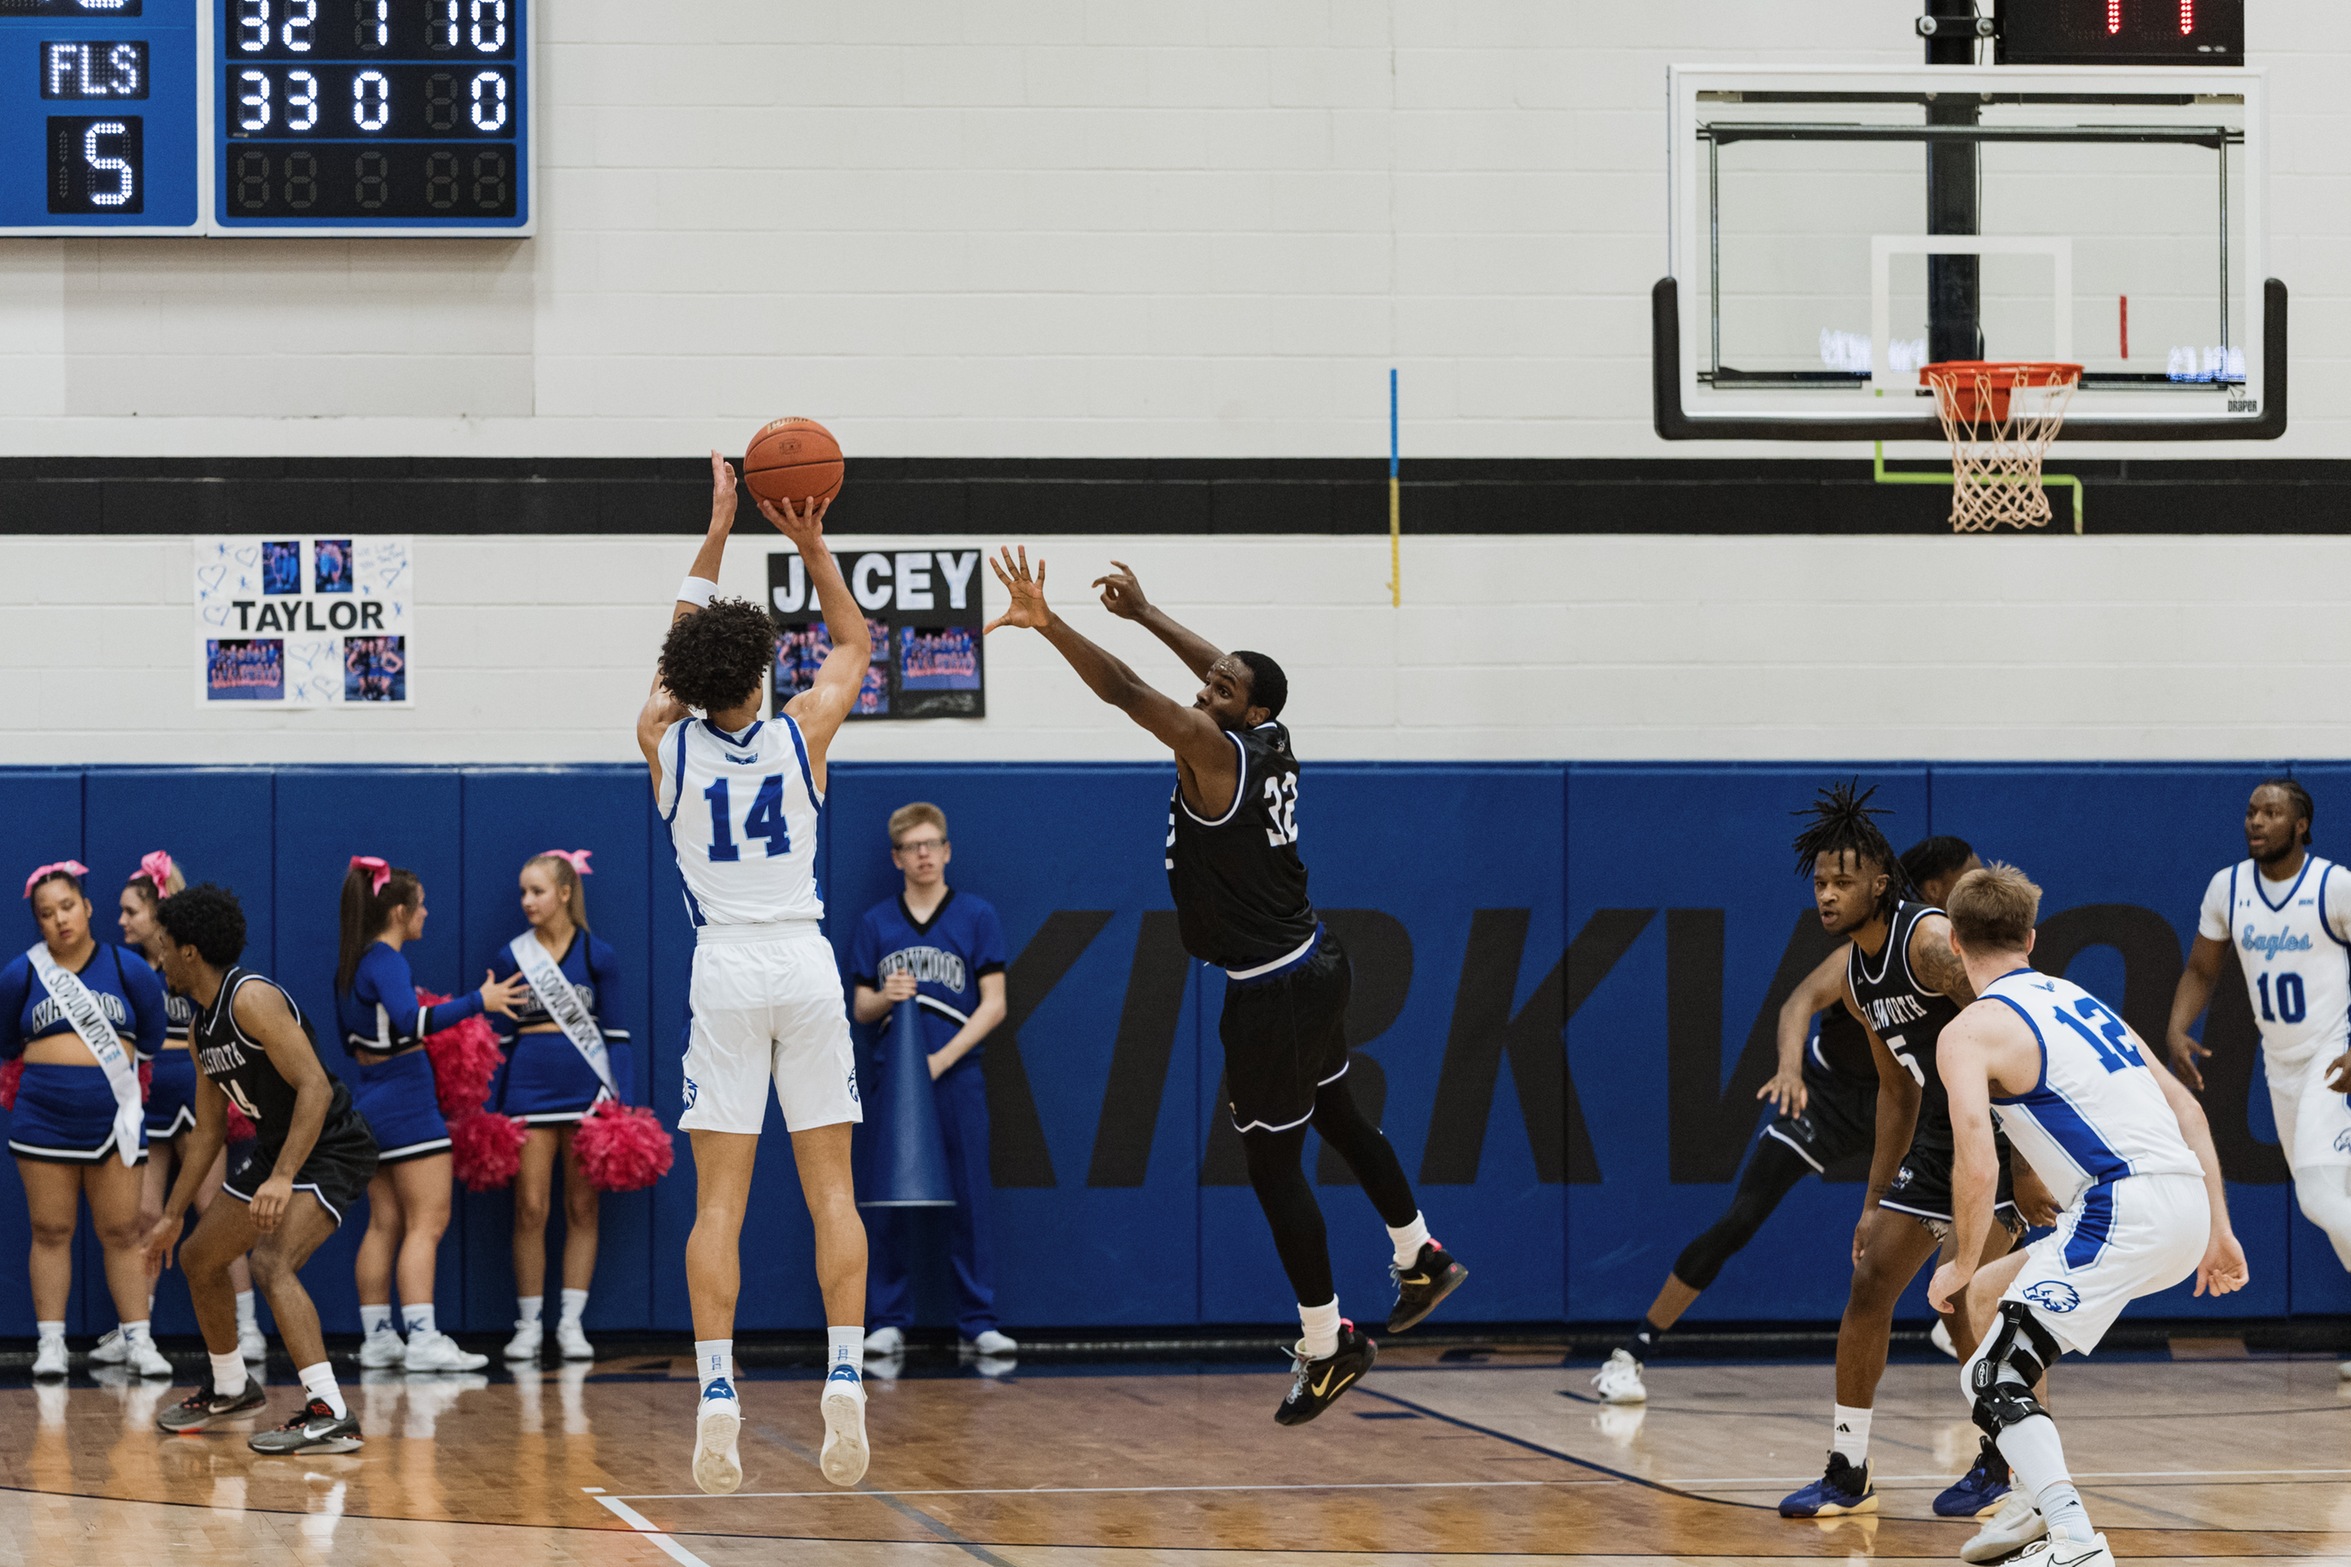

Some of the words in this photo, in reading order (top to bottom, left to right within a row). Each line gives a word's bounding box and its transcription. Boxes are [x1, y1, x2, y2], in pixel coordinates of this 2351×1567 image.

[240, 0, 317, 51] 32
[51, 44, 138, 94] FLS
[240, 70, 318, 130] 33
[353, 71, 389, 131] 0
[471, 71, 506, 131] 0
[85, 122, 132, 205] 5
[232, 600, 384, 632] TAYLOR
[703, 772, 792, 863] 14
[1263, 771, 1299, 847] 32
[2241, 924, 2313, 961] Eagles
[2256, 972, 2306, 1024] 10
[1886, 1034, 1925, 1088] 5
[2051, 997, 2148, 1074] 12
